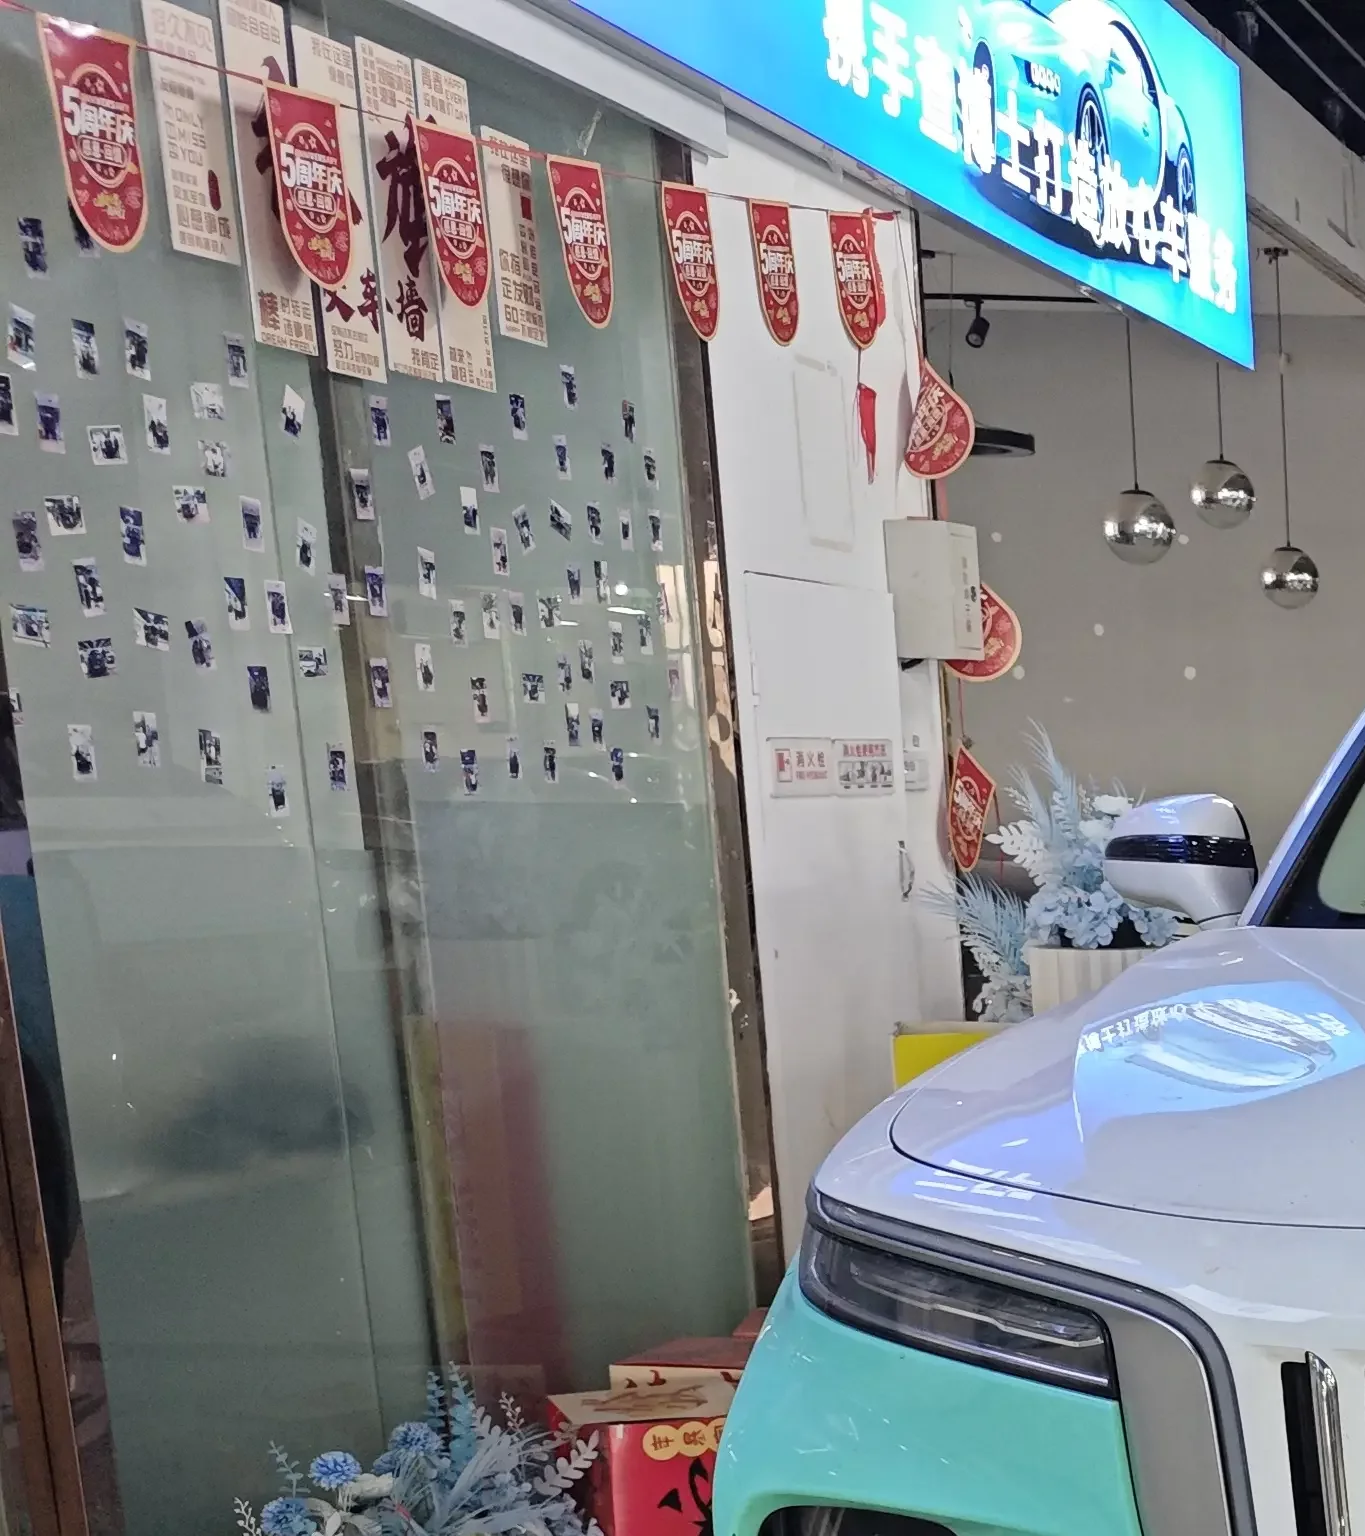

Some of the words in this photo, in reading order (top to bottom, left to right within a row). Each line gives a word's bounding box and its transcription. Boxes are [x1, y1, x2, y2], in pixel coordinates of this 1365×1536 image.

[62, 85, 136, 146] 5周年庆
[280, 142, 343, 196] 5周年庆
[428, 176, 482, 225] 5周年庆
[560, 206, 608, 247] 5周年庆
[671, 229, 714, 265] 5周年庆
[759, 242, 794, 275] 5周年庆
[835, 252, 872, 282] 5周年庆
[332, 338, 355, 361] 努力
[795, 751, 826, 768] 消火栓
